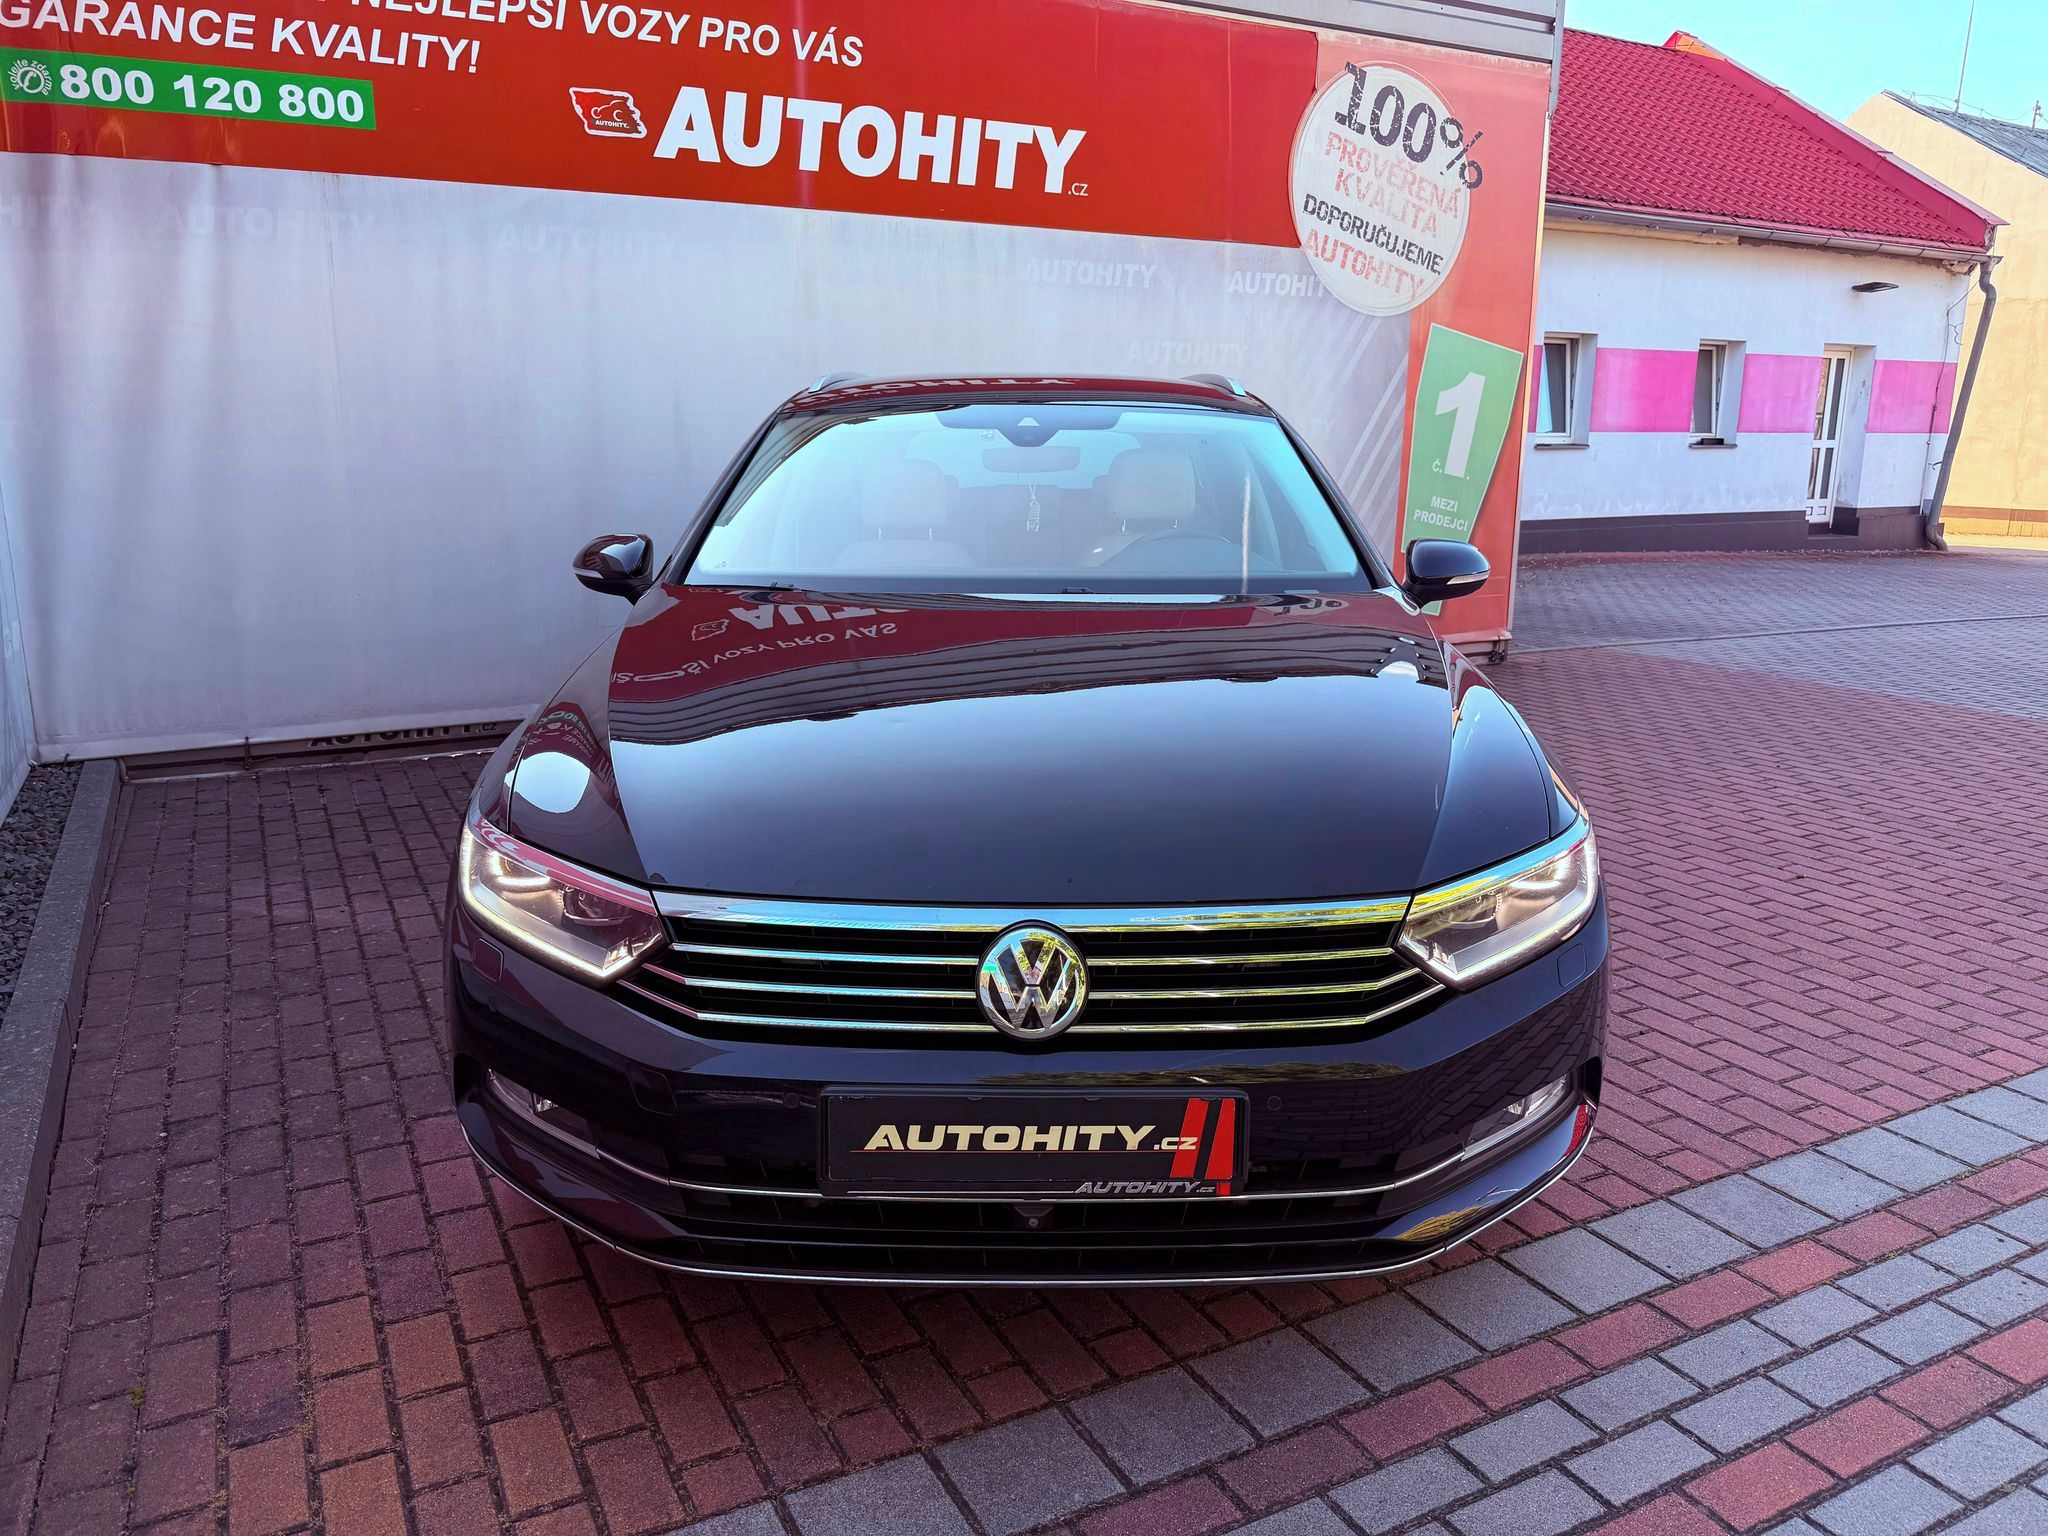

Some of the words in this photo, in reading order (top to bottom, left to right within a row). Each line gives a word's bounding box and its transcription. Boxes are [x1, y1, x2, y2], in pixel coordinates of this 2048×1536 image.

[0, 0, 256, 50] GARANCE
[271, 17, 480, 73] KVALITY!
[581, 0, 691, 44] VOZY
[699, 17, 780, 56] PRO
[792, 27, 864, 67] VÁS
[60, 64, 154, 104] 800
[173, 75, 261, 113] 120
[279, 85, 364, 123] 800
[1335, 61, 1484, 190] 100%
[1302, 192, 1444, 276] DOPORUČUJEME
[1334, 168, 1438, 239] KVALITA
[1024, 257, 1157, 289] AUTOHITY
[1227, 271, 1324, 298] AUTOHIT
[1305, 228, 1425, 301] AUTOHITY
[1413, 509, 1469, 531] PRODEJCI
[1430, 495, 1458, 512] MEZI
